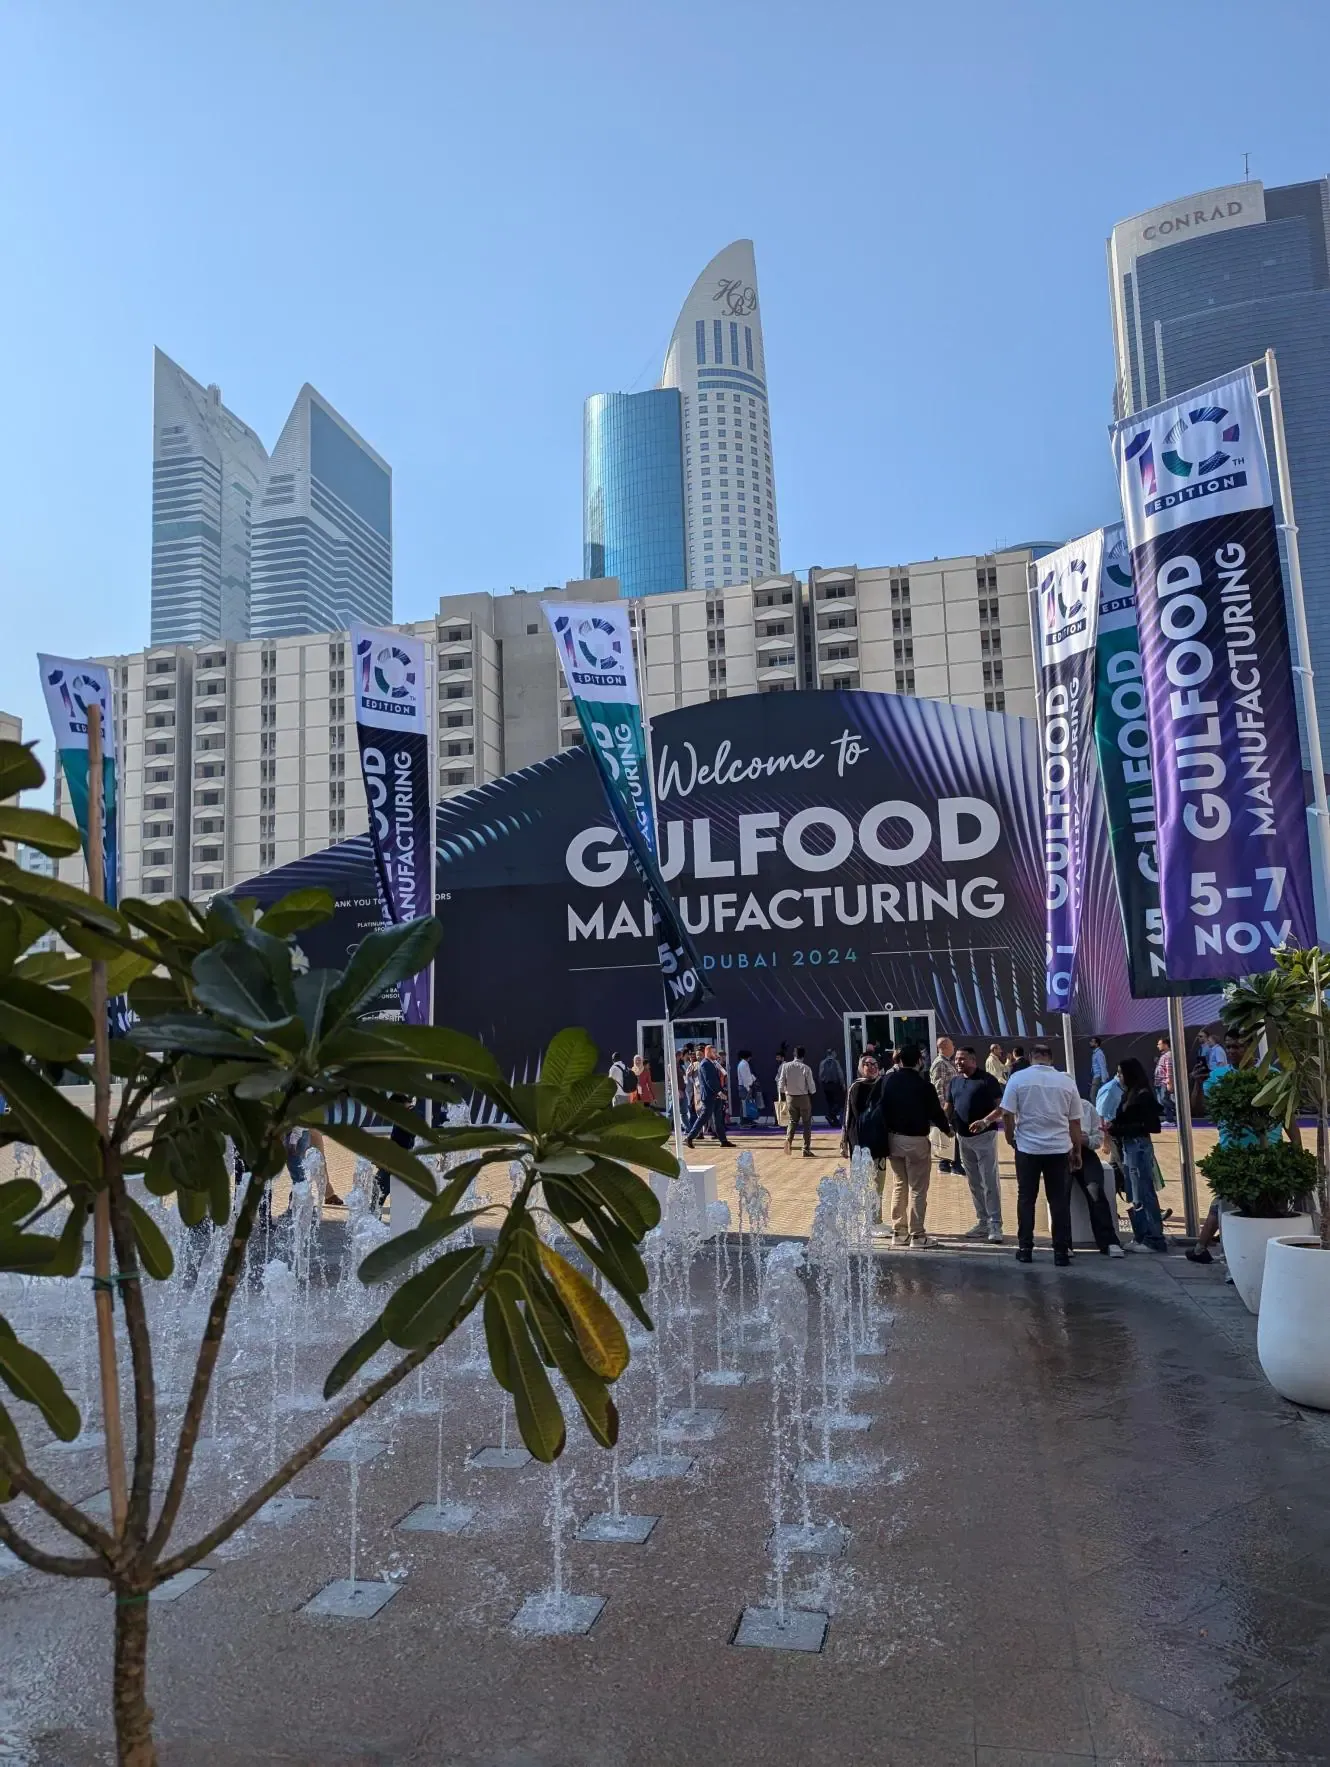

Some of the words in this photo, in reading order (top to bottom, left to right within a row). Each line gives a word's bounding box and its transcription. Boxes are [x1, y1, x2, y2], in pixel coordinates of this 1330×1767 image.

[1143, 201, 1243, 241] CONRAD
[1153, 475, 1235, 511] EDITION
[1101, 598, 1135, 613] EDIT
[578, 675, 622, 684] EDITION
[1156, 554, 1232, 842] GULFOOD
[1214, 542, 1278, 836] MANUFACTURING
[365, 700, 411, 714] EDITION
[657, 739, 825, 801] Welcome
[830, 728, 870, 778] to
[1045, 684, 1071, 910] GULFOOD
[393, 751, 416, 924] ANUFACTURING
[565, 796, 1001, 888] GULFOOD
[334, 899, 352, 908] ANK
[354, 898, 371, 907] YOU
[1194, 919, 1292, 956] NOV
[703, 951, 777, 970] DUBAI
[792, 947, 857, 966] 2024
